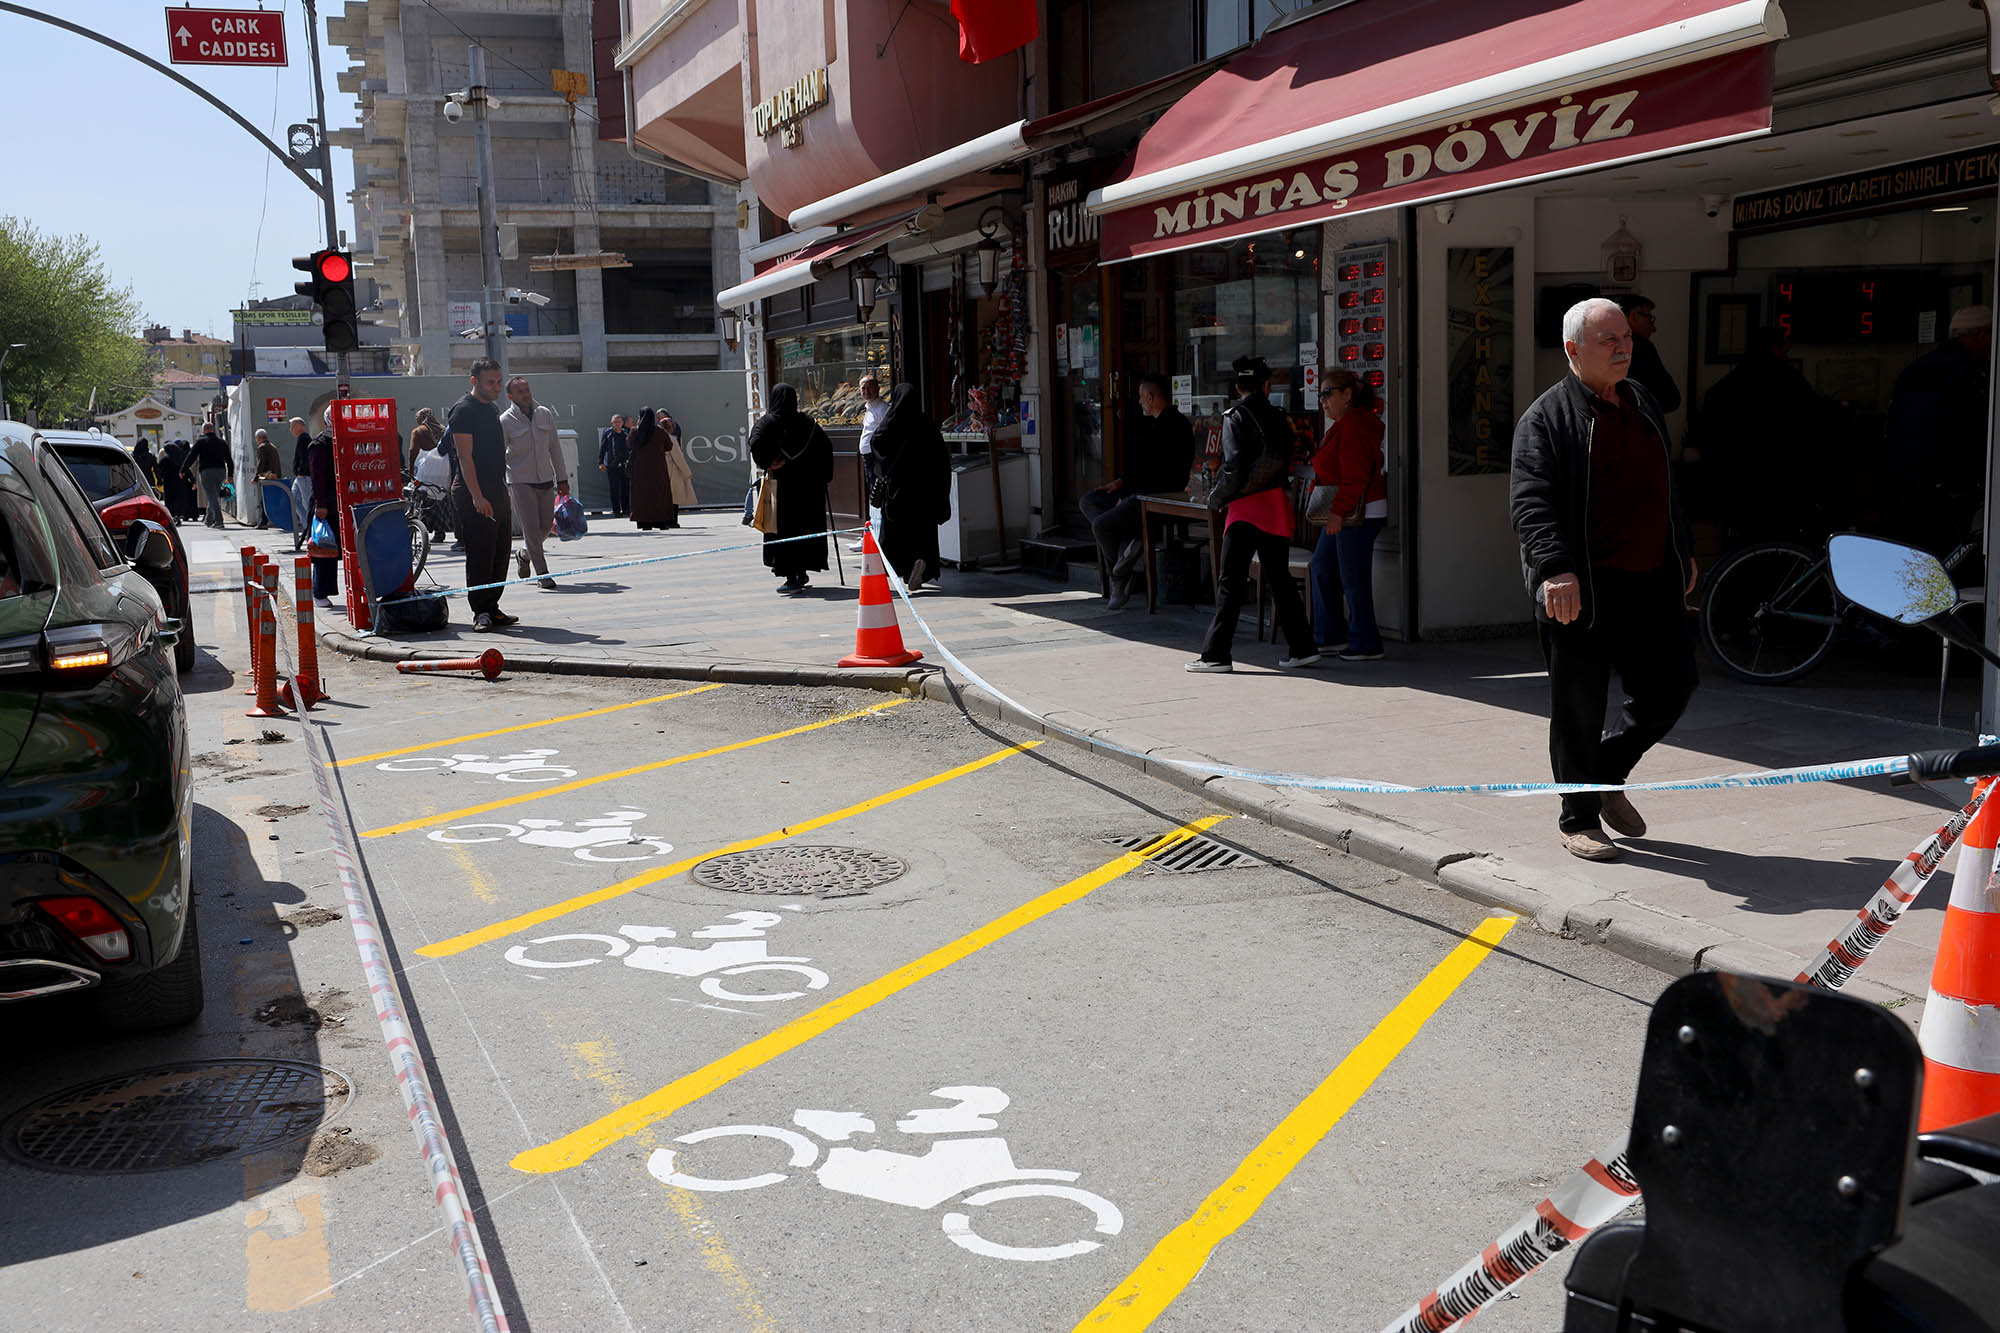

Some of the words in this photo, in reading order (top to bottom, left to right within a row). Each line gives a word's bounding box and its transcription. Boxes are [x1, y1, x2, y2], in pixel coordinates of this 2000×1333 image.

[211, 17, 260, 35] ÇARK
[199, 40, 276, 58] CADDESİ
[751, 86, 794, 137] TOPLAR
[1152, 159, 1360, 238] MİNTAŞ
[1381, 88, 1641, 189] DÖVİZ
[1784, 188, 1824, 215] DÖVİZ
[1827, 174, 1892, 208] TİCARETİ
[1779, 283, 1792, 302] 4
[1861, 282, 1875, 301] 4
[1860, 312, 1873, 334] 5
[1474, 255, 1494, 465] EXCHANGE
